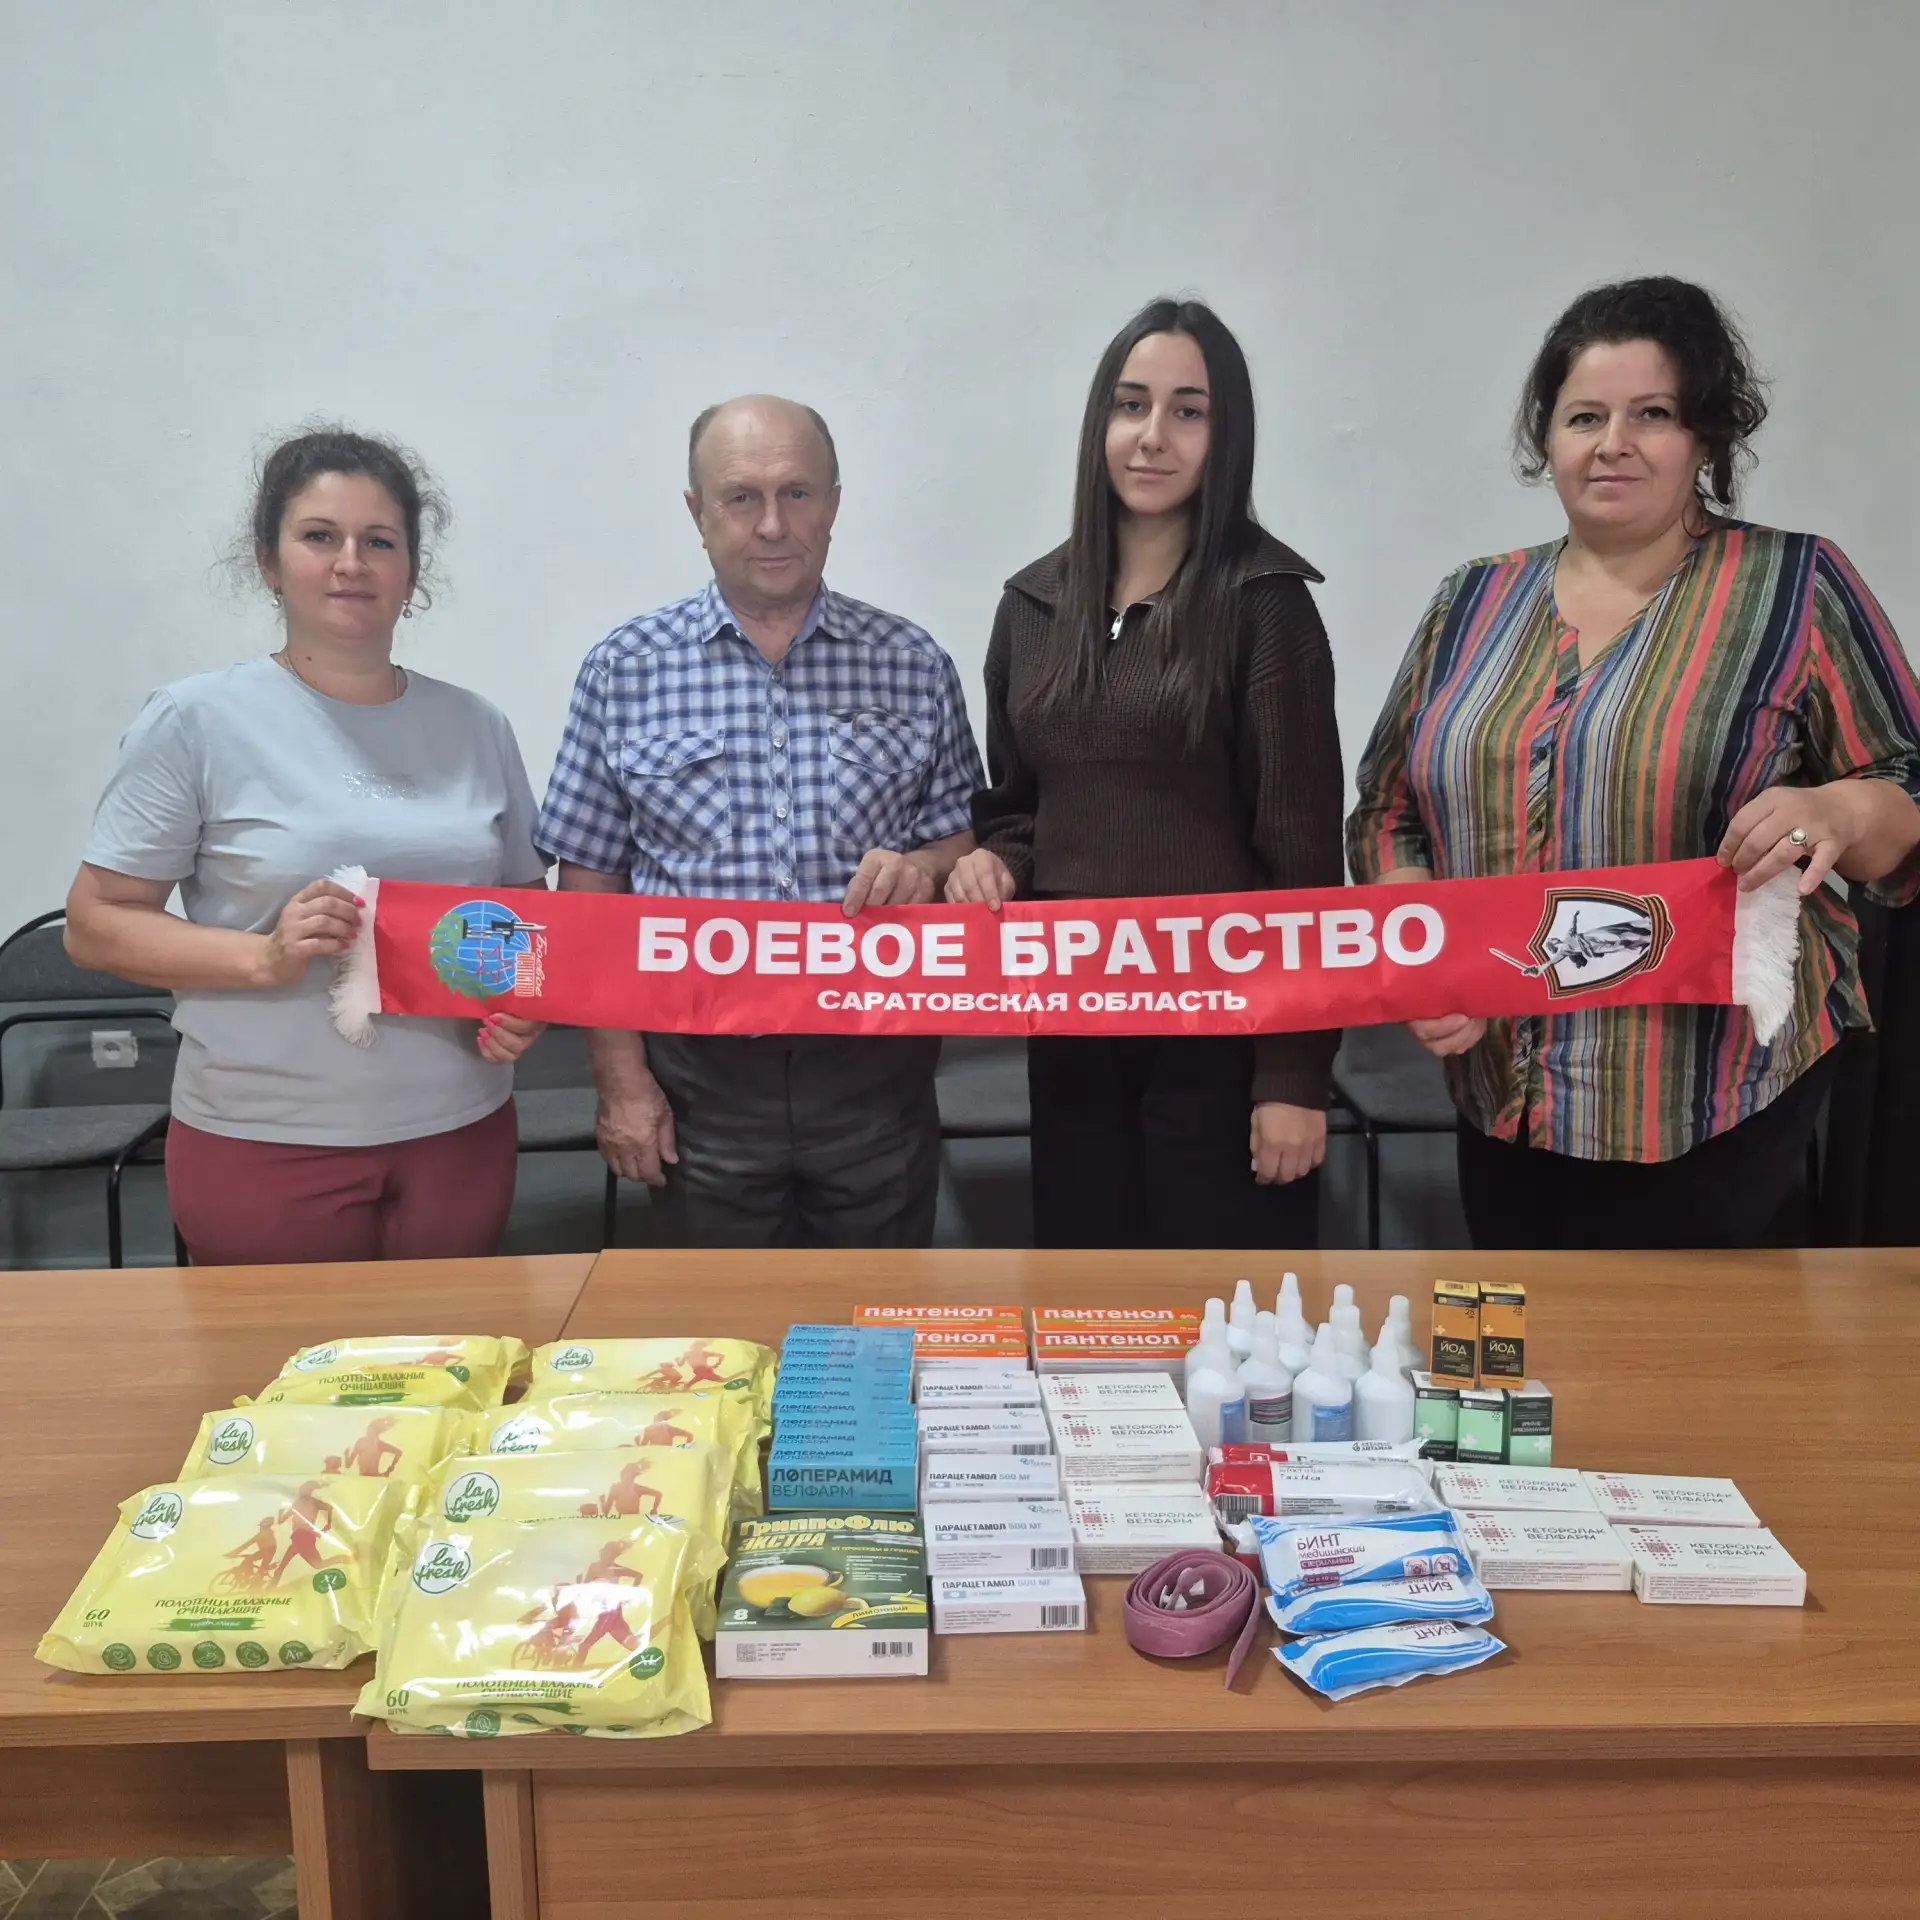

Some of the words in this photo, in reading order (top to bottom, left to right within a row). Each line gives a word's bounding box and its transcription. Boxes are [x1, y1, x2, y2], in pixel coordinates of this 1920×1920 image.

[637, 916, 967, 977] БОЕВОЕ
[1000, 903, 1445, 977] БРАТСТВО
[817, 989, 1068, 1013] САРАТОВСКАЯ
[1077, 989, 1248, 1013] ОБЛАСТЬ
[915, 1332, 996, 1344] тенол
[1440, 1340, 1467, 1356] ЙОД
[1489, 1340, 1516, 1356] ЙОД
[220, 1422, 241, 1438] la
[772, 1468, 893, 1485] ЛОПЕРАМИД
[462, 1477, 485, 1499] la
[772, 1485, 854, 1497] ВЕЛФАРМ
[1652, 1489, 1734, 1498] КЕТОРОЛАК
[147, 1496, 168, 1514] la
[449, 1488, 497, 1515] fresh
[1655, 1495, 1724, 1503] ВЕЛФАРМ
[131, 1502, 180, 1533] fresh
[935, 1522, 1007, 1532] ПАРАЦЕТАМОЛ
[1523, 1527, 1606, 1535] КЕТОРОЛАК
[739, 1533, 828, 1551] ЭКСТРА
[1297, 1532, 1341, 1551] БИНТ
[1527, 1533, 1597, 1541] ВЕЛФАРМ
[1299, 1545, 1366, 1559] медицинский
[1689, 1542, 1775, 1551] КЕТОРОЛАК
[1693, 1548, 1766, 1556] ВЕЛФАРМ
[431, 1547, 456, 1567] la
[415, 1561, 467, 1587] fresh
[942, 1579, 1016, 1589] ПАРАЦЕТАМОЛ
[1408, 1581, 1454, 1595] БИНТ
[155, 1598, 230, 1608] ПОЛОТЕНЦА
[232, 1597, 293, 1607] ВЛАЖНЫЕ
[85, 1608, 111, 1621] 60
[176, 1606, 264, 1616] ОЧИЩАЮЩИЕ
[733, 1608, 749, 1620] 8
[1414, 1624, 1457, 1640] БИНТ
[385, 1689, 410, 1708] 60
